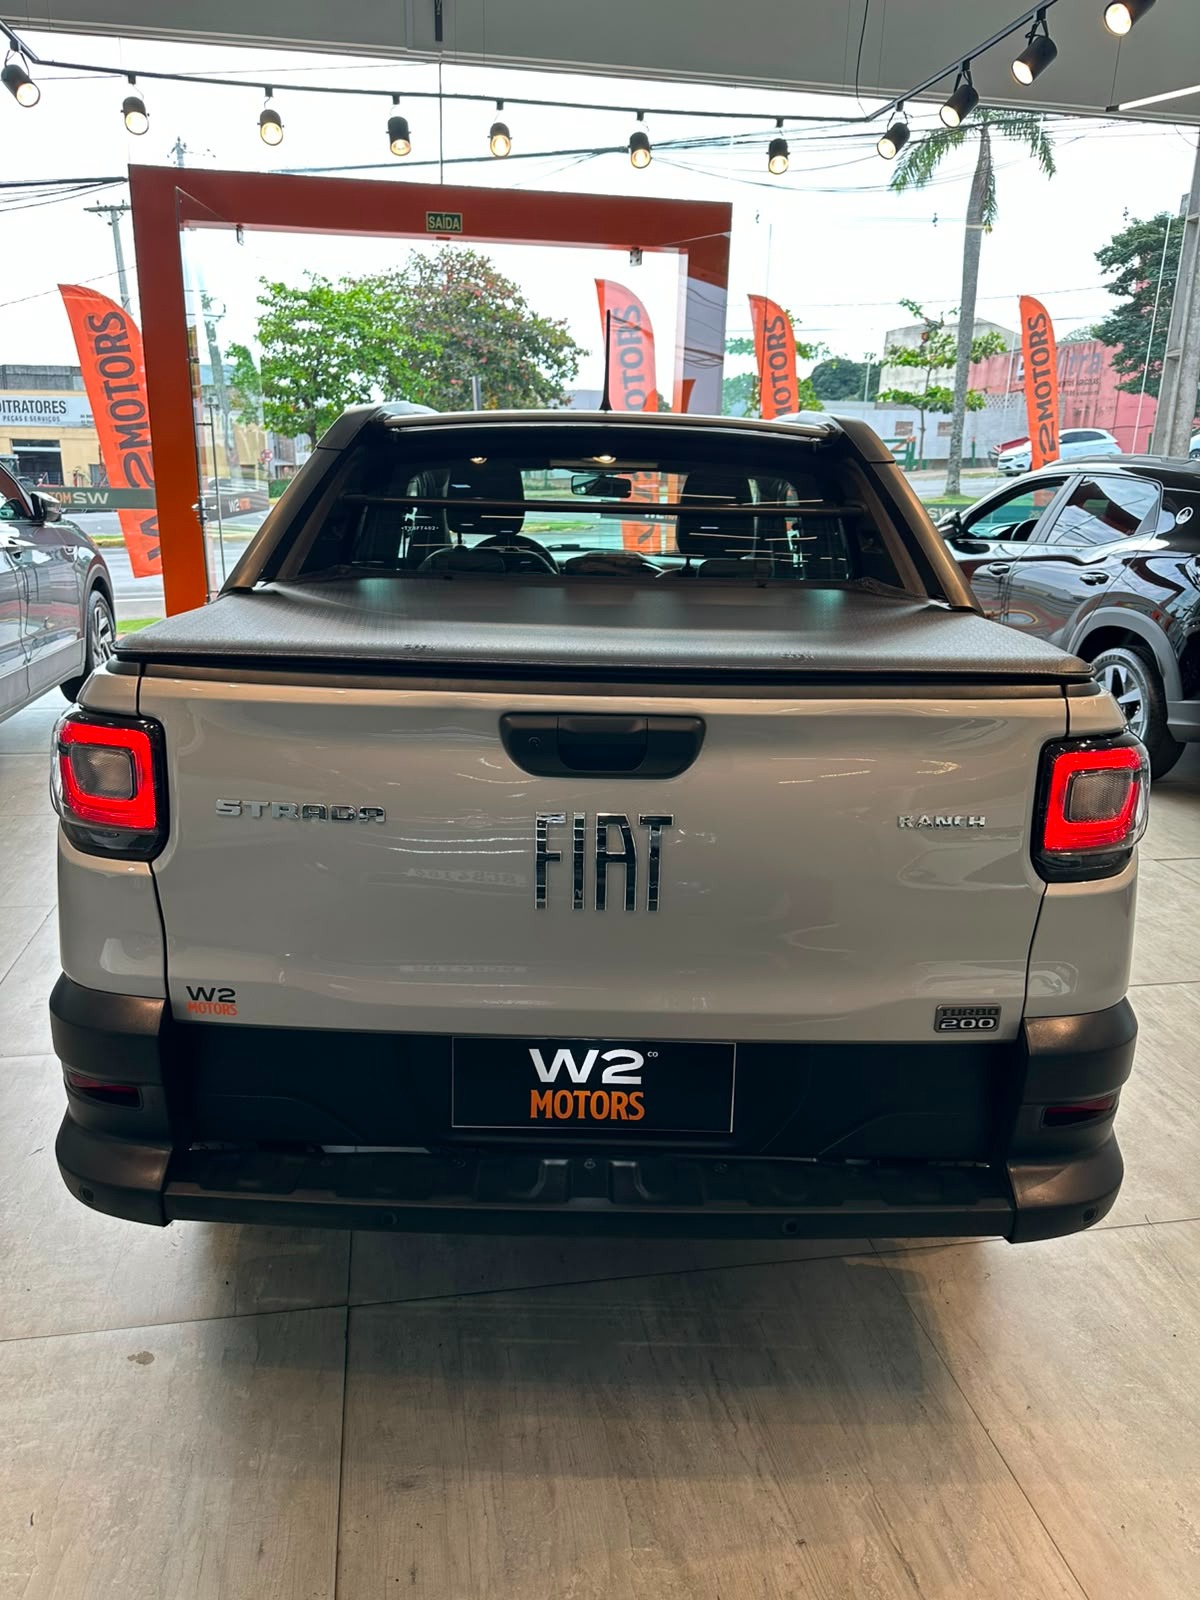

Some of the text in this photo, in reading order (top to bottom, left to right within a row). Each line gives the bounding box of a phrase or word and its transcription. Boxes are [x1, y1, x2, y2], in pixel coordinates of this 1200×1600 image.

[428, 213, 460, 230] SAÍDA
[616, 303, 647, 411] OTORS
[1028, 312, 1054, 422] MOTORS
[88, 310, 150, 450] MOTORS
[0, 400, 67, 414] ITRATORES
[215, 799, 386, 823] STRADA
[898, 814, 986, 828] RANCH
[535, 811, 674, 912] FIAT
[186, 986, 236, 1003] W2
[187, 1001, 238, 1016] MOTORS
[941, 1008, 1000, 1016] TURBO
[940, 1018, 996, 1029] 200
[528, 1048, 645, 1085] W2
[530, 1089, 646, 1121] MOTORS
